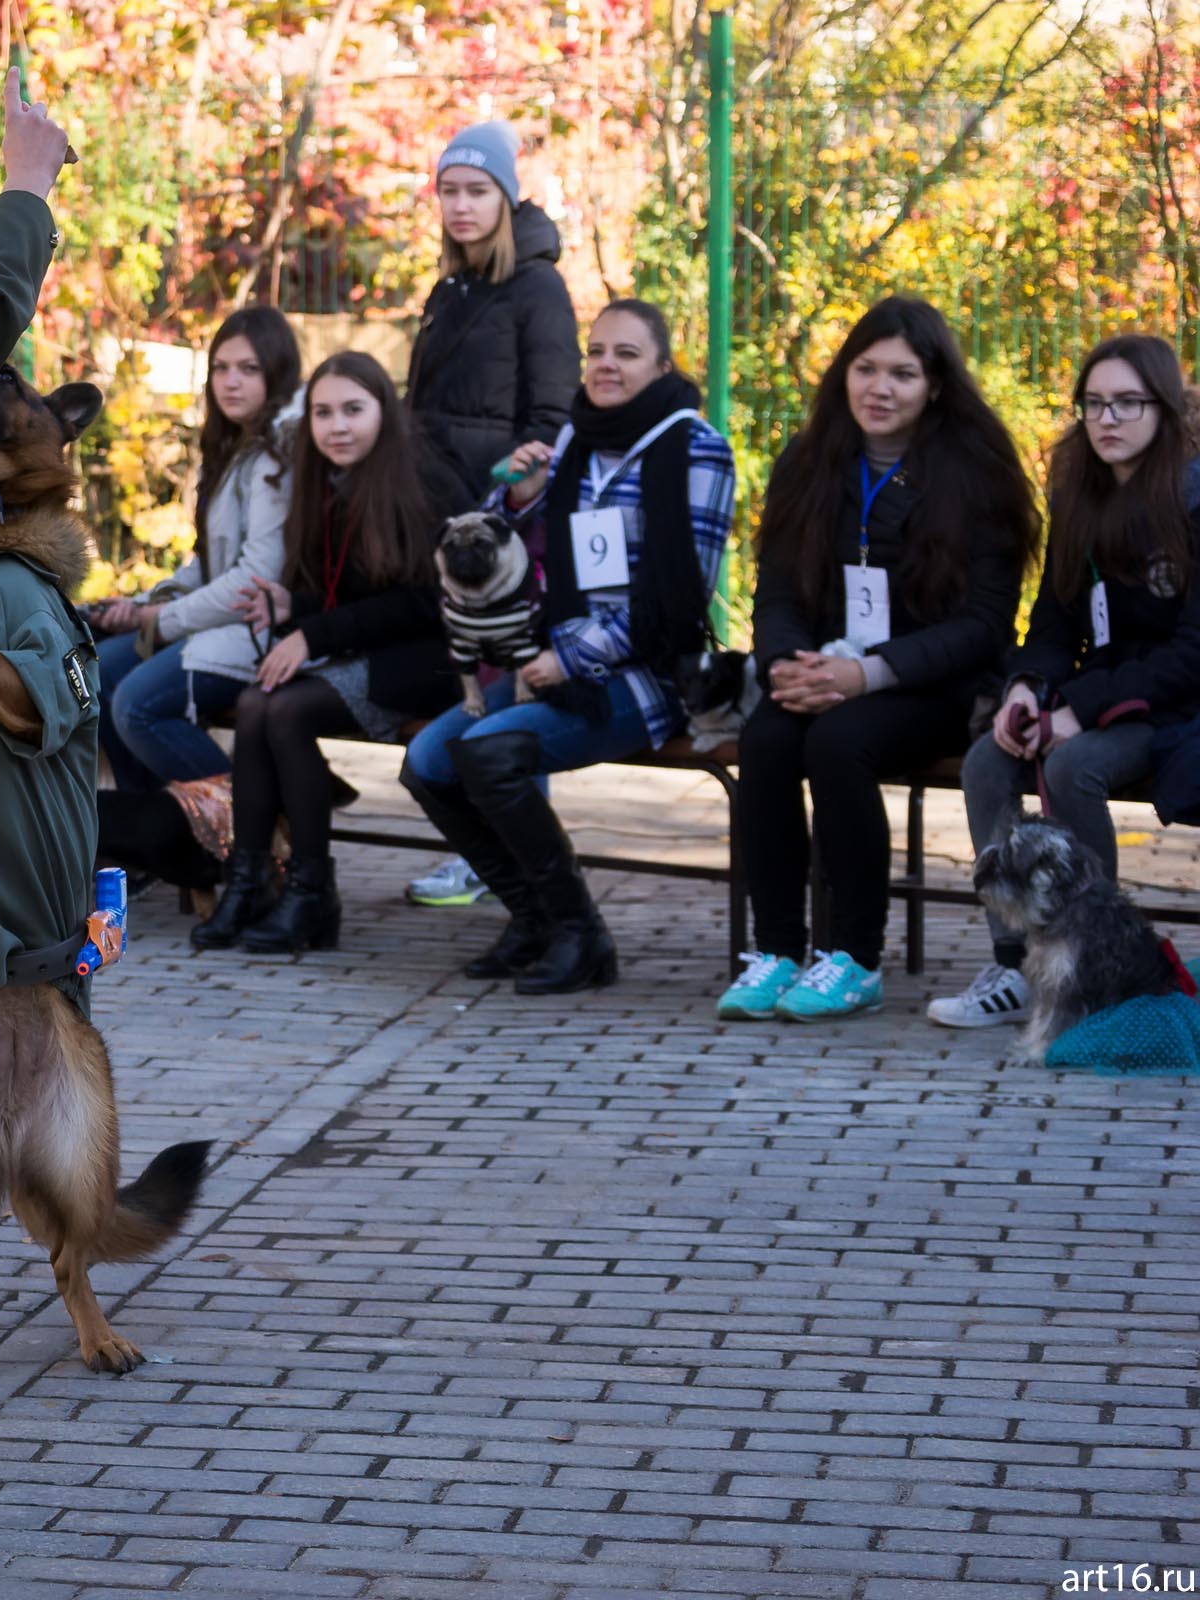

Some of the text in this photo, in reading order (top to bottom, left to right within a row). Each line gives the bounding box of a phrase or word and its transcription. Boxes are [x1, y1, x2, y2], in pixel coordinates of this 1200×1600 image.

[590, 533, 608, 567] 9
[859, 586, 873, 617] 3
[69, 669, 83, 696] МВД
